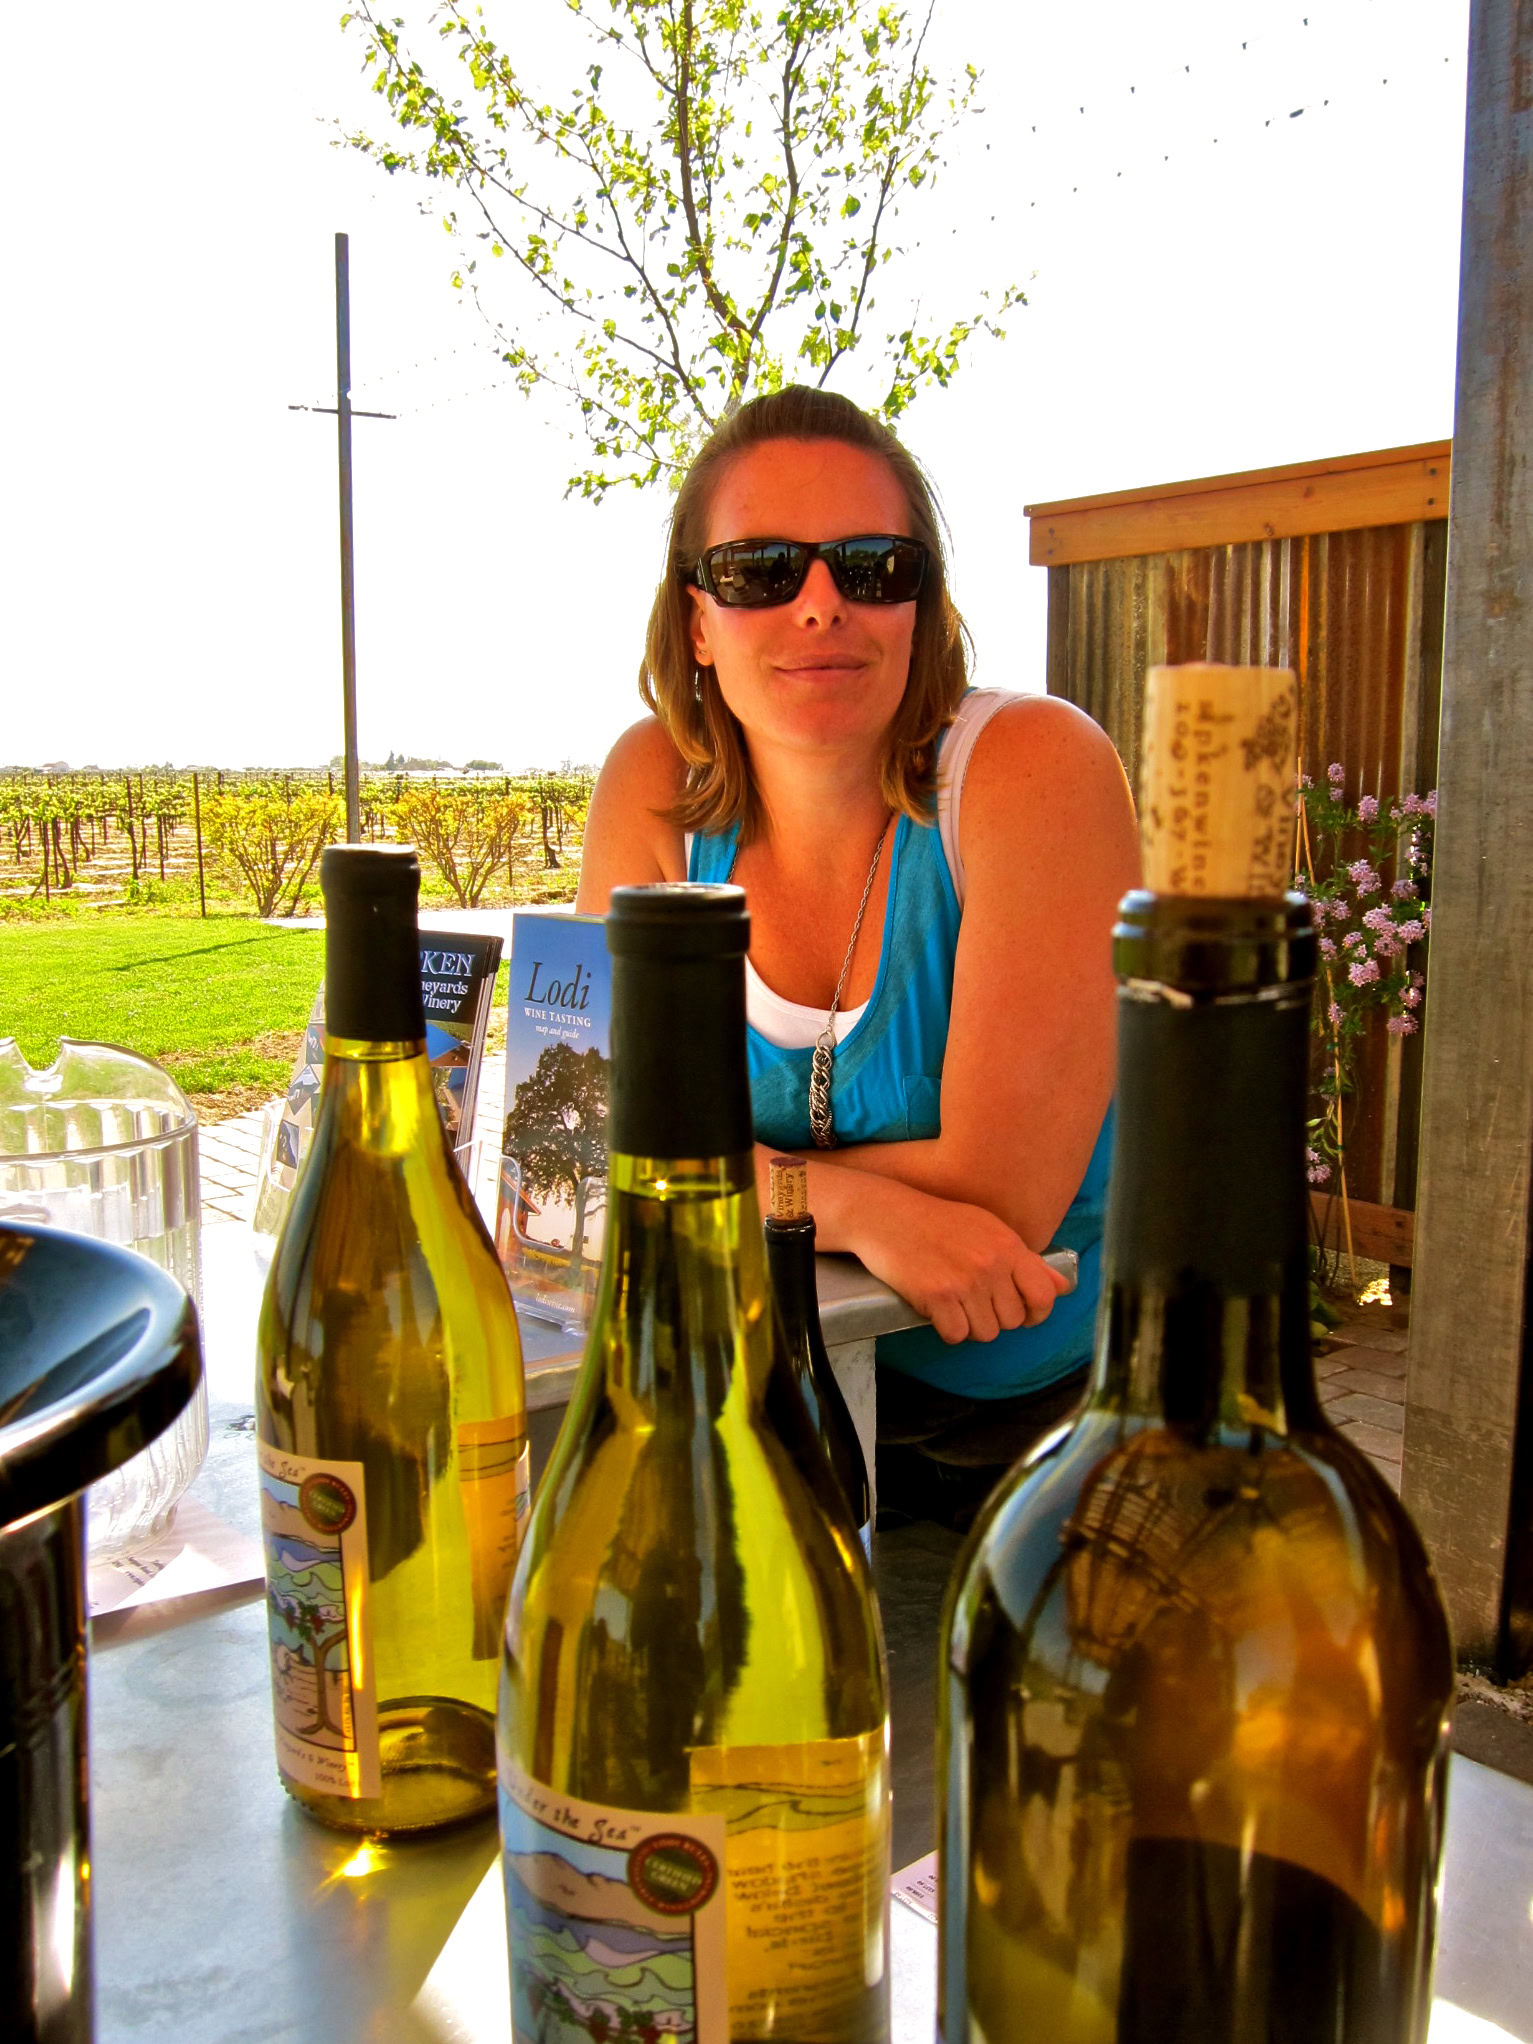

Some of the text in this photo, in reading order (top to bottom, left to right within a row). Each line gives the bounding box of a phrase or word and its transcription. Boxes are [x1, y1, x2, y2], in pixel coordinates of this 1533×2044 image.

[420, 950, 476, 977] KEN
[524, 961, 592, 1011] Lodi
[523, 1006, 592, 1028] WINE TASTING
[535, 1025, 580, 1040] map and guide
[553, 1807, 580, 1830] the
